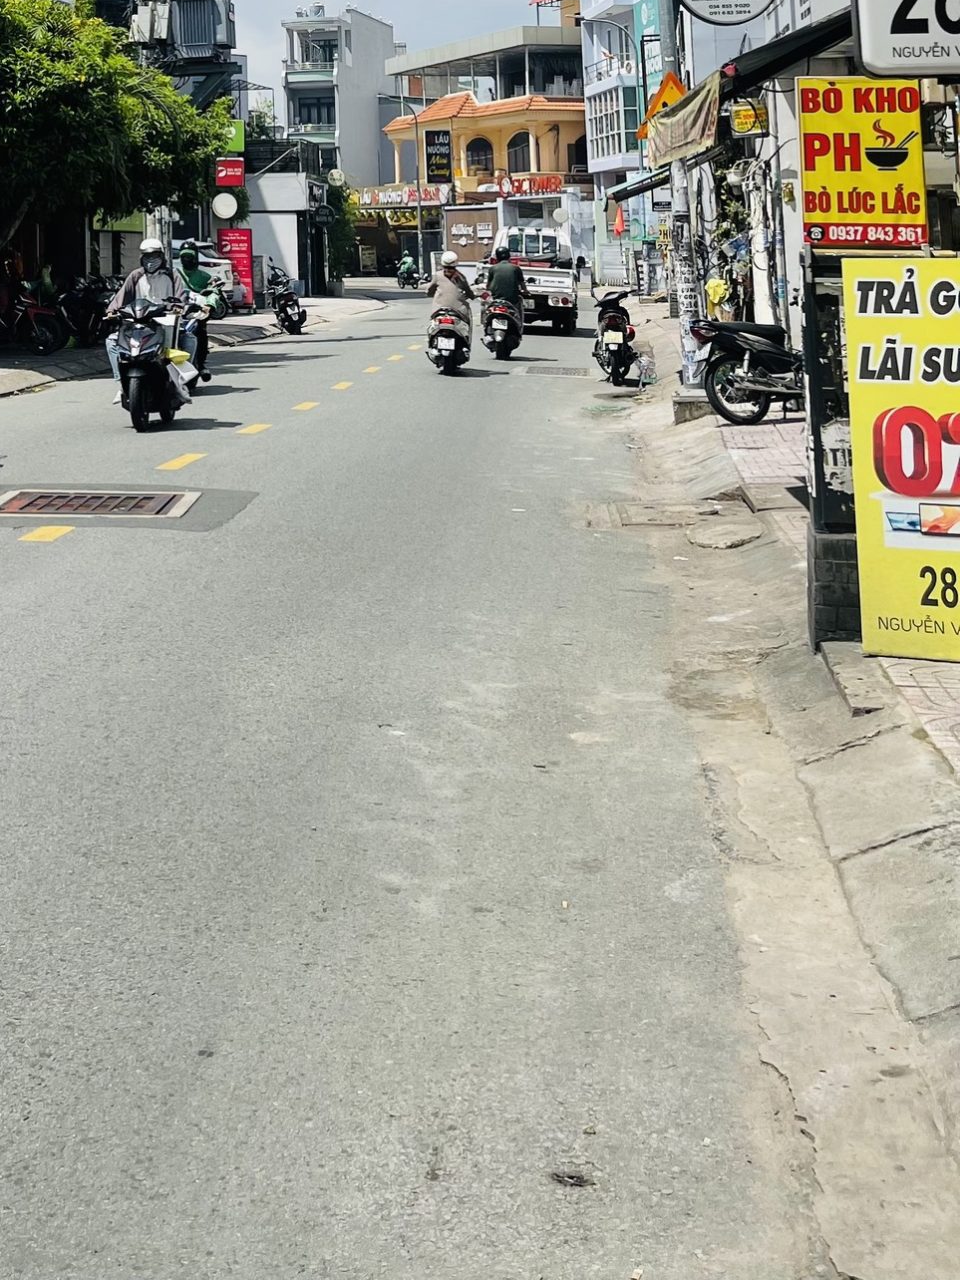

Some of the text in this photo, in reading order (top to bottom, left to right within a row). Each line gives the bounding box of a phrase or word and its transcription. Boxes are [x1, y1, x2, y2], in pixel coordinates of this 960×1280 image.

[891, 41, 951, 59] NGUYỄN
[800, 81, 920, 114] BÒ KHO
[804, 183, 921, 215] BÒ LÚC LẮC
[828, 226, 923, 242] 0937 843 361
[856, 268, 960, 317] TRẢ G
[859, 337, 912, 382] LÃI
[920, 564, 959, 609] 28
[878, 615, 945, 635] NGUYỄN
